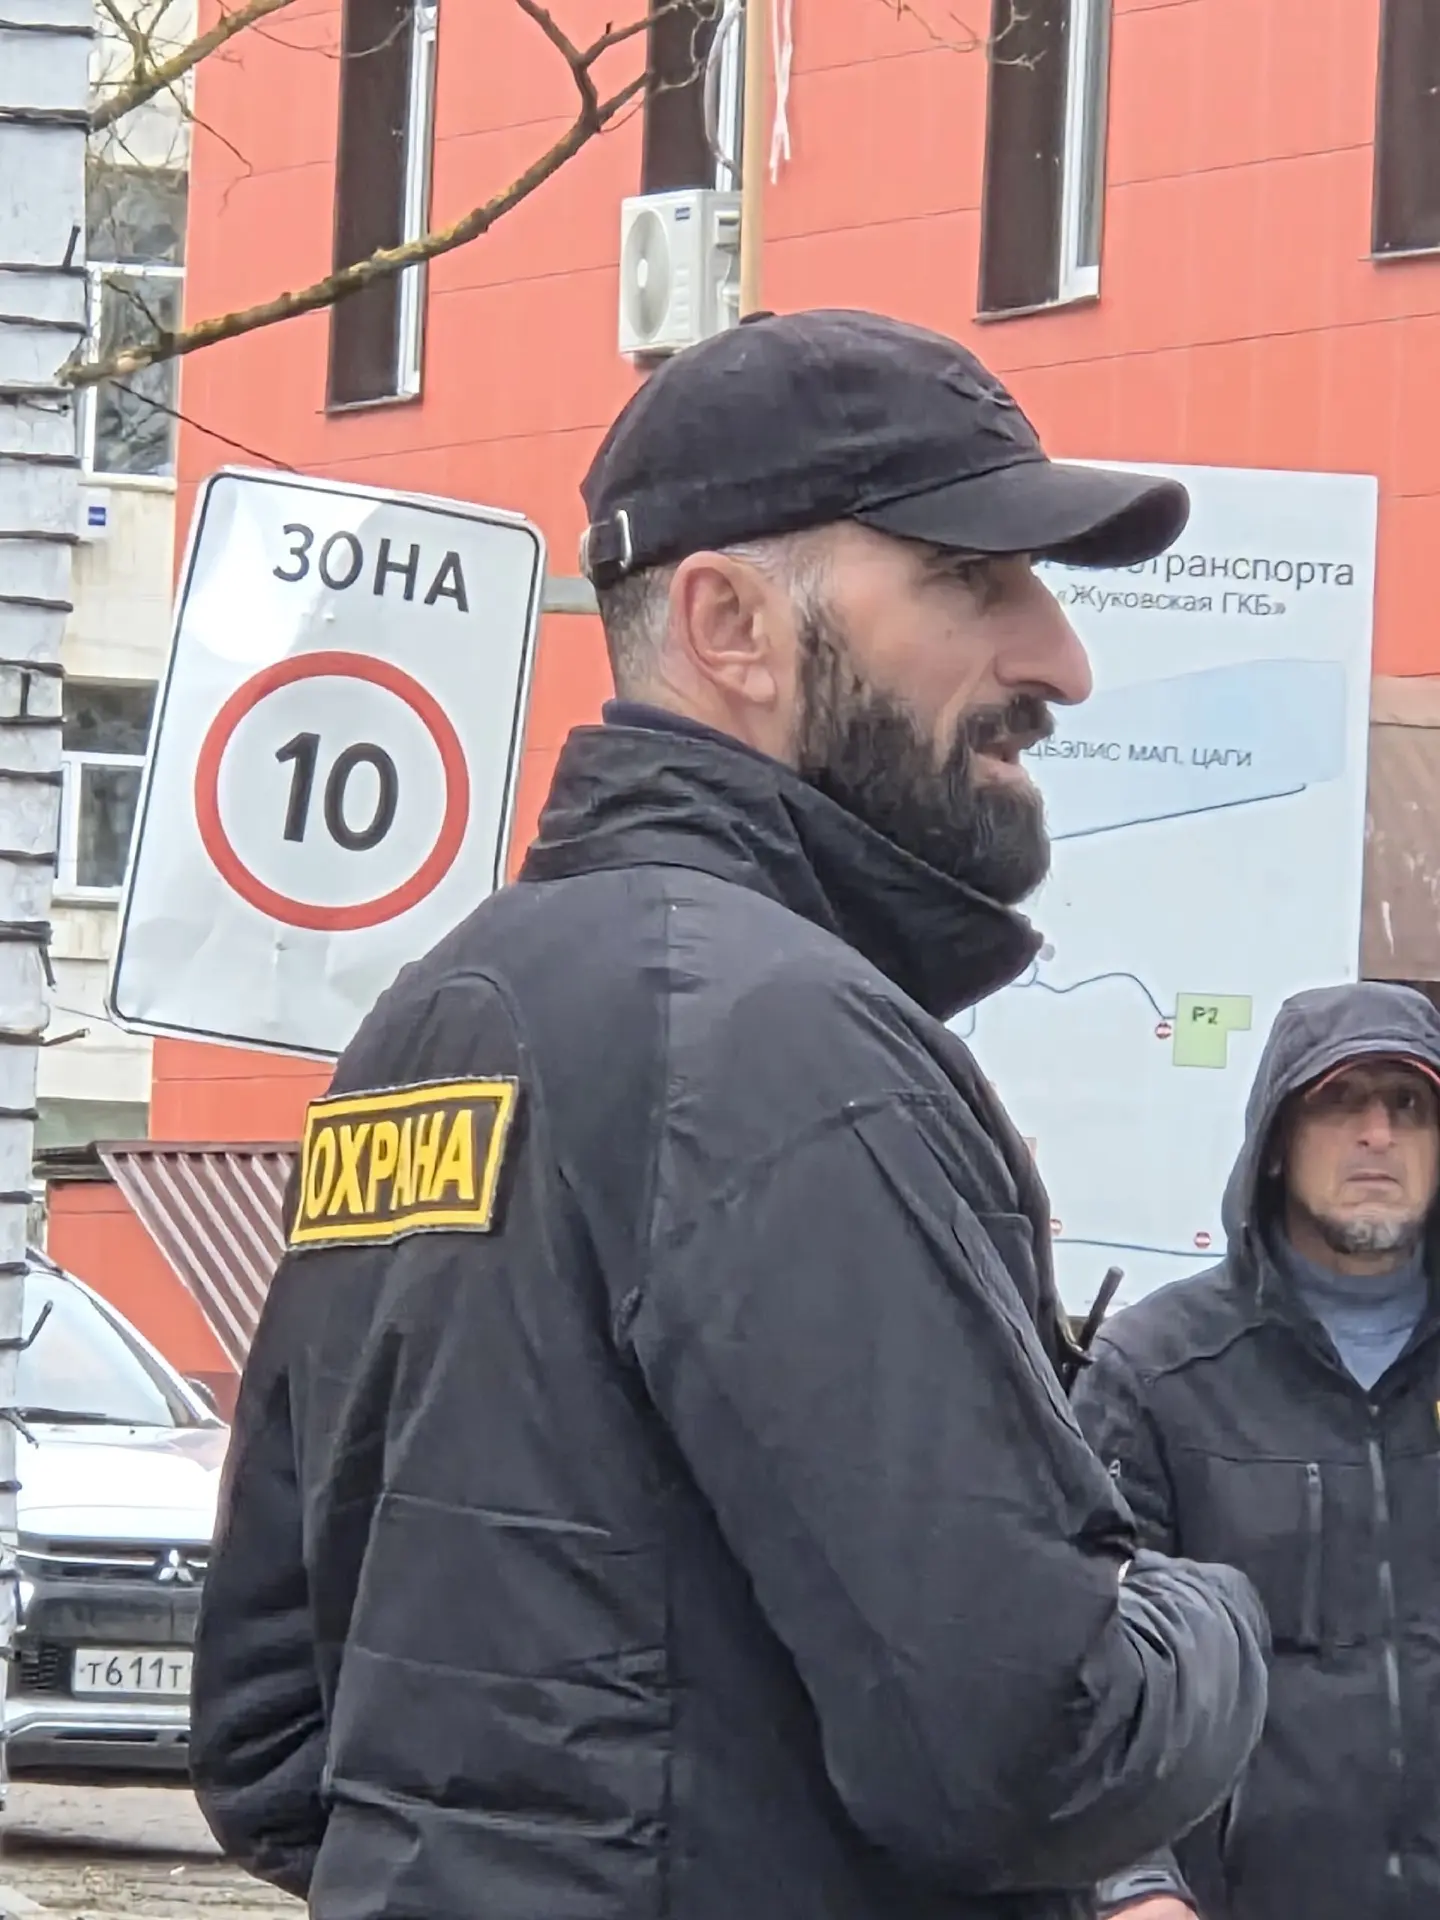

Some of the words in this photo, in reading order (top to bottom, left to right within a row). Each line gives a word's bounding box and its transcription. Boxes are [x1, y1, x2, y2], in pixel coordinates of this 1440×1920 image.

[272, 523, 470, 613] ЗОНА
[1066, 553, 1354, 591] транспорта
[1192, 748, 1252, 769] ЦАГИ
[275, 732, 399, 852] 10
[87, 1656, 186, 1688] Т611Т
